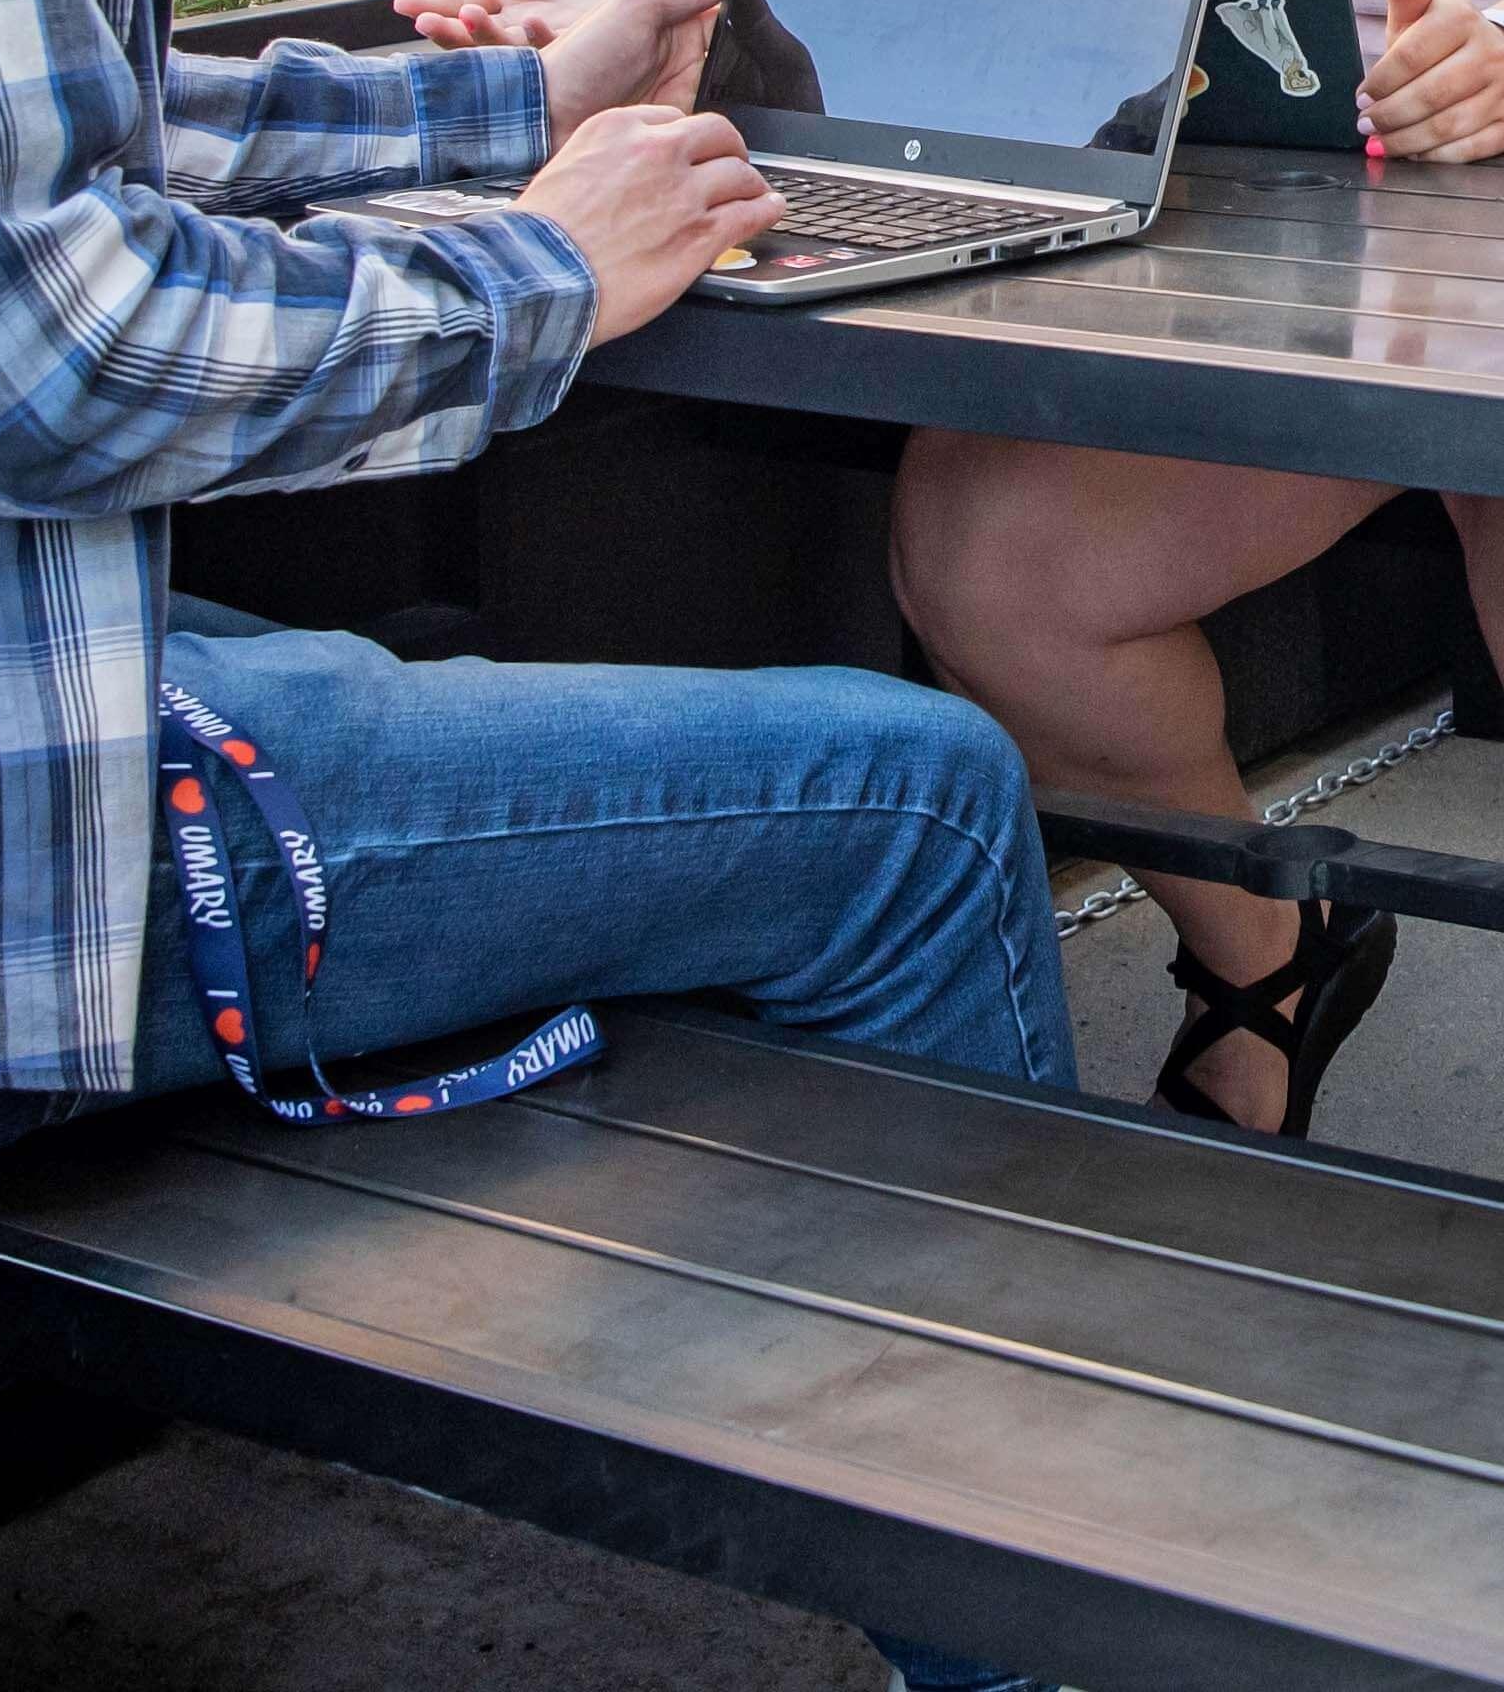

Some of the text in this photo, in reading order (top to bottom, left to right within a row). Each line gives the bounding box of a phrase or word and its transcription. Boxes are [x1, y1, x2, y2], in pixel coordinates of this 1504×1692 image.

[178, 825, 233, 929] UMARY
[278, 829, 326, 931] UMARY
[506, 1011, 596, 1088] UMARY
